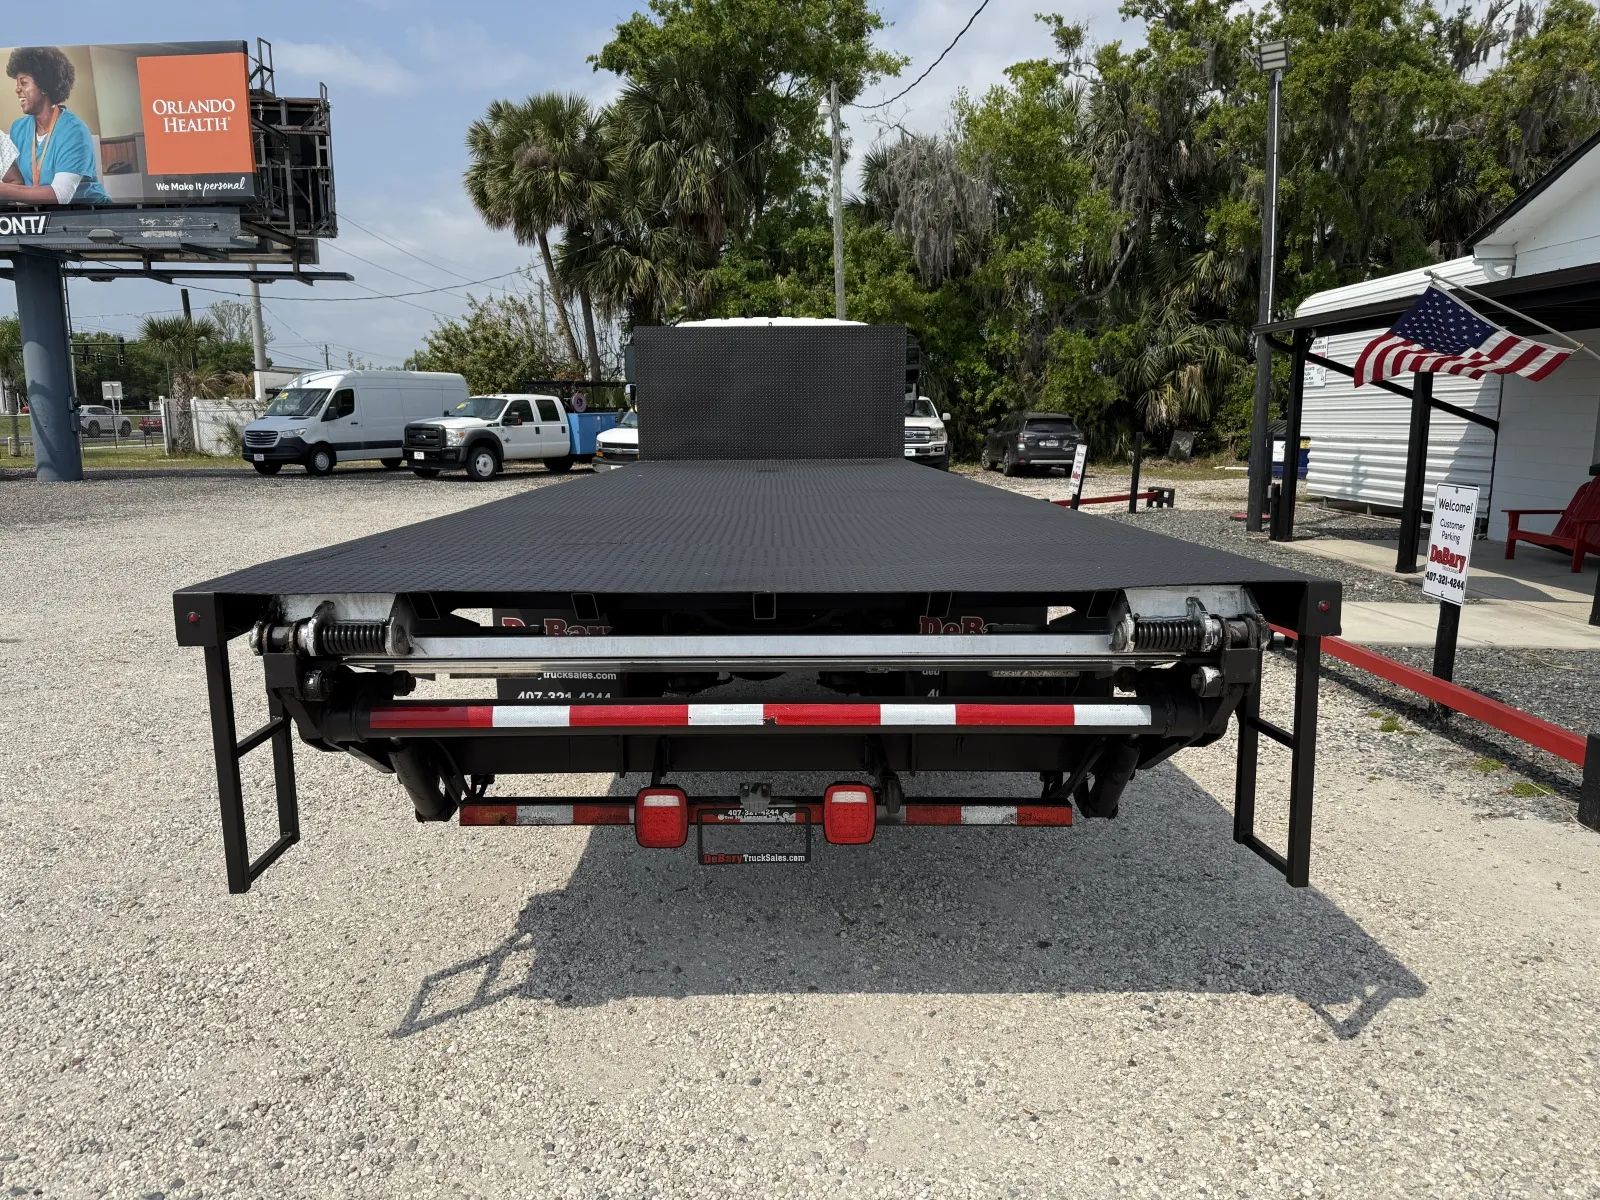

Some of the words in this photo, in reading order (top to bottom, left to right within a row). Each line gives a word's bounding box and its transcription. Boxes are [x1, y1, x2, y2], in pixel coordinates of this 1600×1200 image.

[152, 98, 236, 115] ORLANDO
[155, 182, 170, 191] We
[171, 181, 194, 191] Make
[195, 181, 203, 190] It
[202, 176, 246, 197] personal
[1438, 498, 1474, 514] Welcome!
[1440, 518, 1466, 531] Customer
[1441, 530, 1461, 546] Parking
